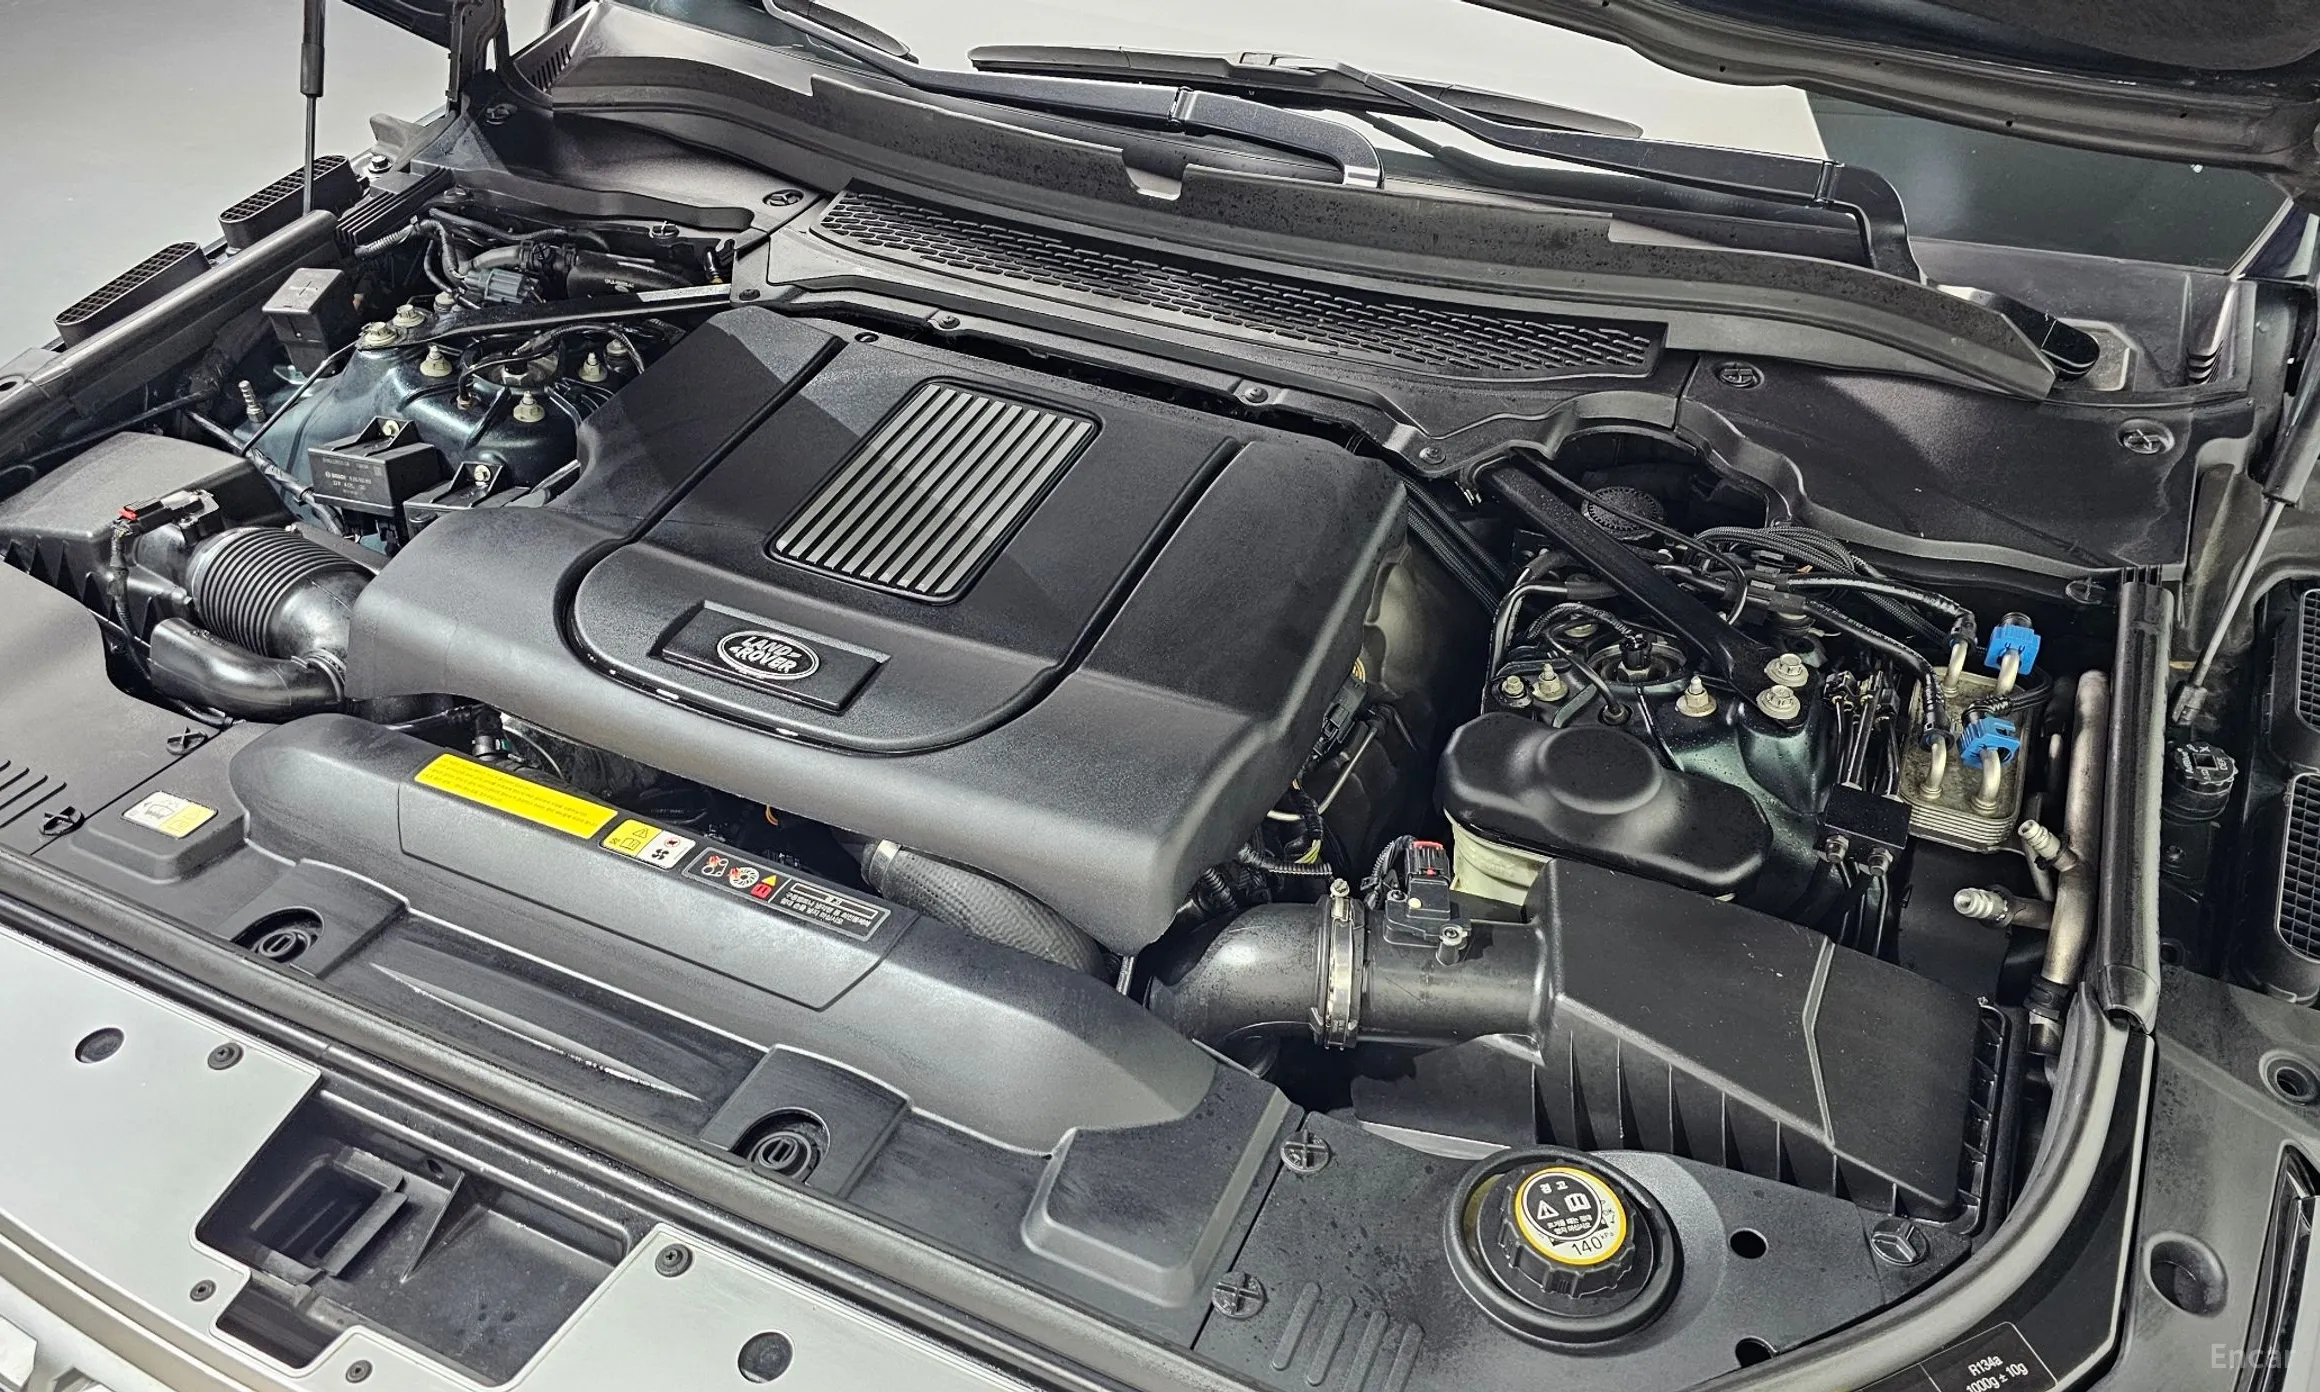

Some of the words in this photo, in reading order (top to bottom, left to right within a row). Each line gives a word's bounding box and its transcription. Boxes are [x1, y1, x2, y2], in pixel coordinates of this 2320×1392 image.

[741, 636, 792, 657] LAND
[735, 646, 797, 673] ROVER
[1572, 1236, 1603, 1256] 140
[1968, 1356, 2003, 1376] R134a
[1966, 1376, 2000, 1392] 1000g
[2006, 1362, 2029, 1378] 10g
